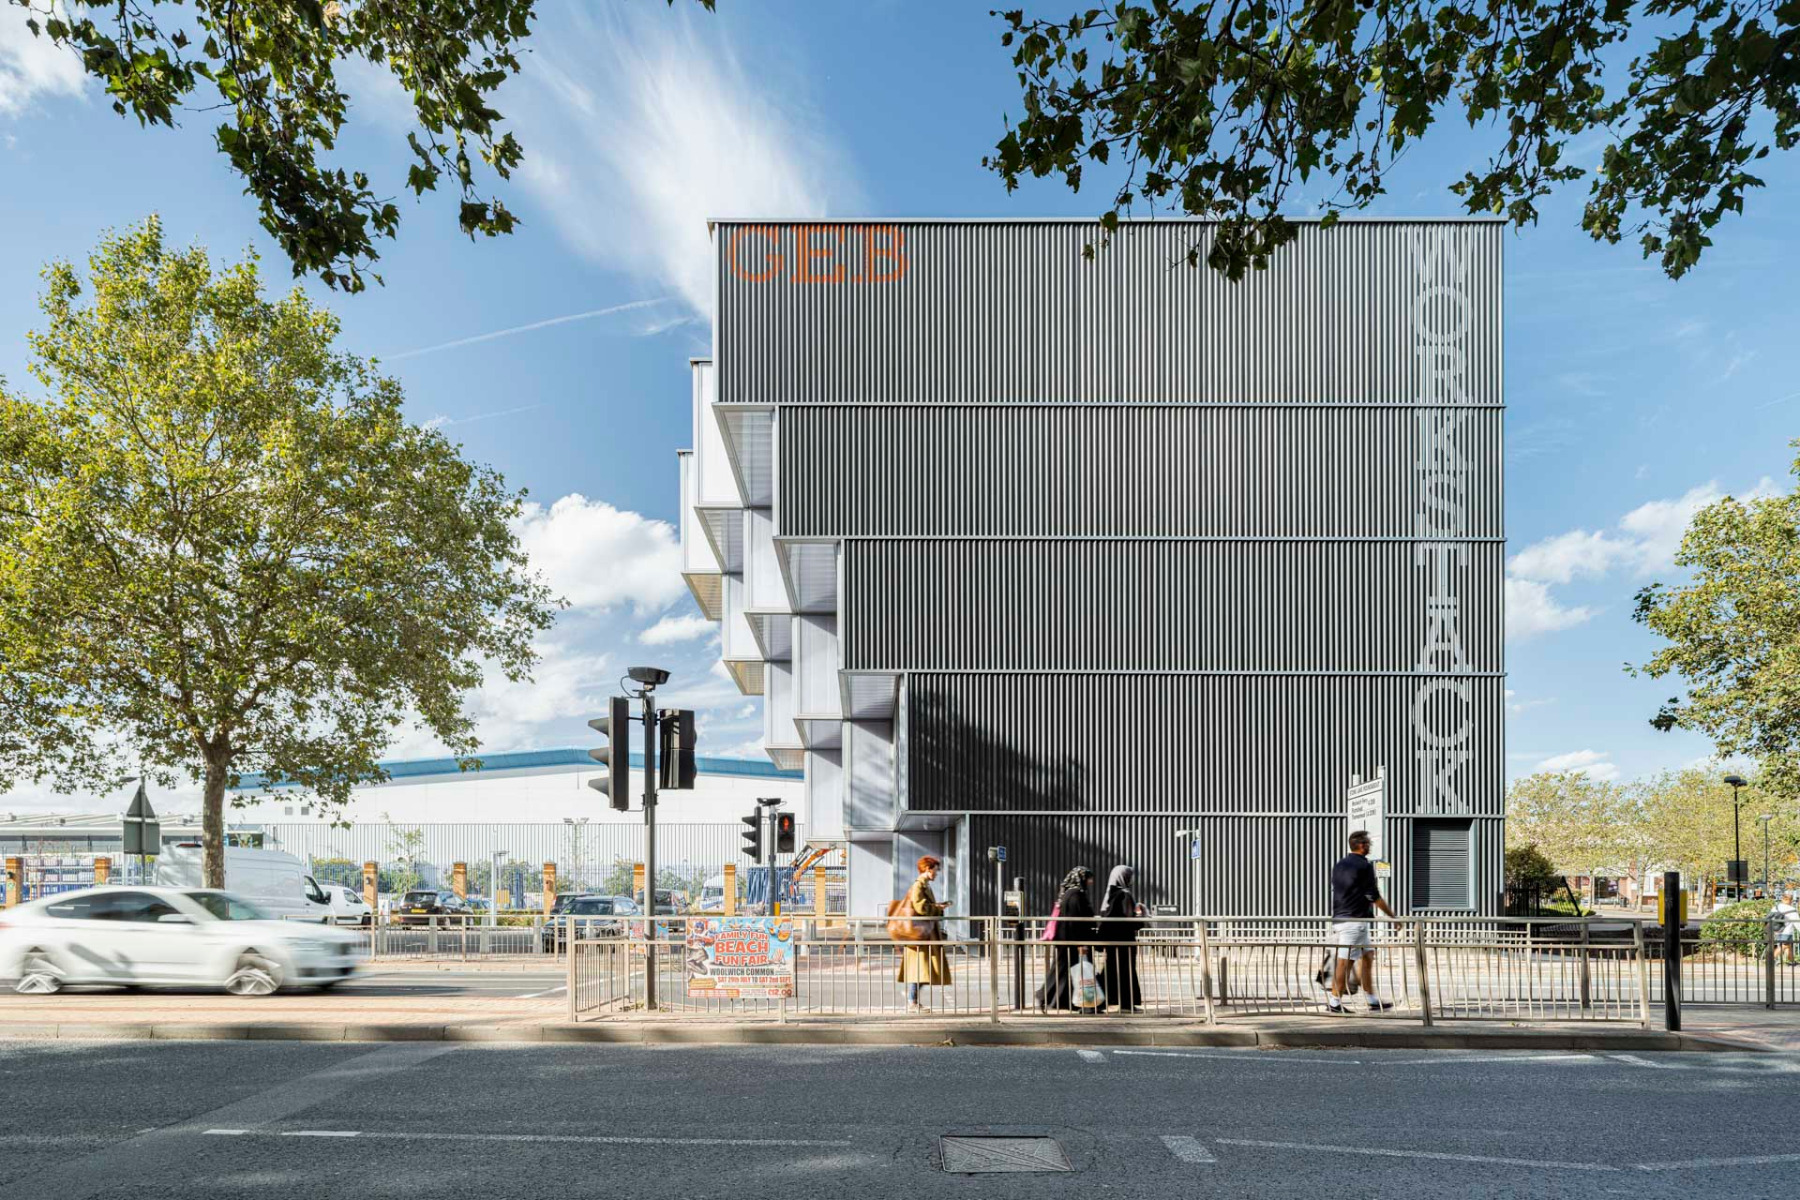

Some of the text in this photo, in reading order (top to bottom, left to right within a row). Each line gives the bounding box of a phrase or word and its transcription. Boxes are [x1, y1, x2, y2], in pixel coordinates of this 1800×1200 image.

[726, 224, 909, 284] GEB
[1407, 225, 1478, 813] WORKSTACK
[715, 931, 768, 940] FAMILY FUN
[715, 940, 768, 953] BEACH
[714, 954, 768, 965] FUN FAIR
[710, 967, 745, 976] WOOLWICH
[746, 967, 774, 976] COMMON
